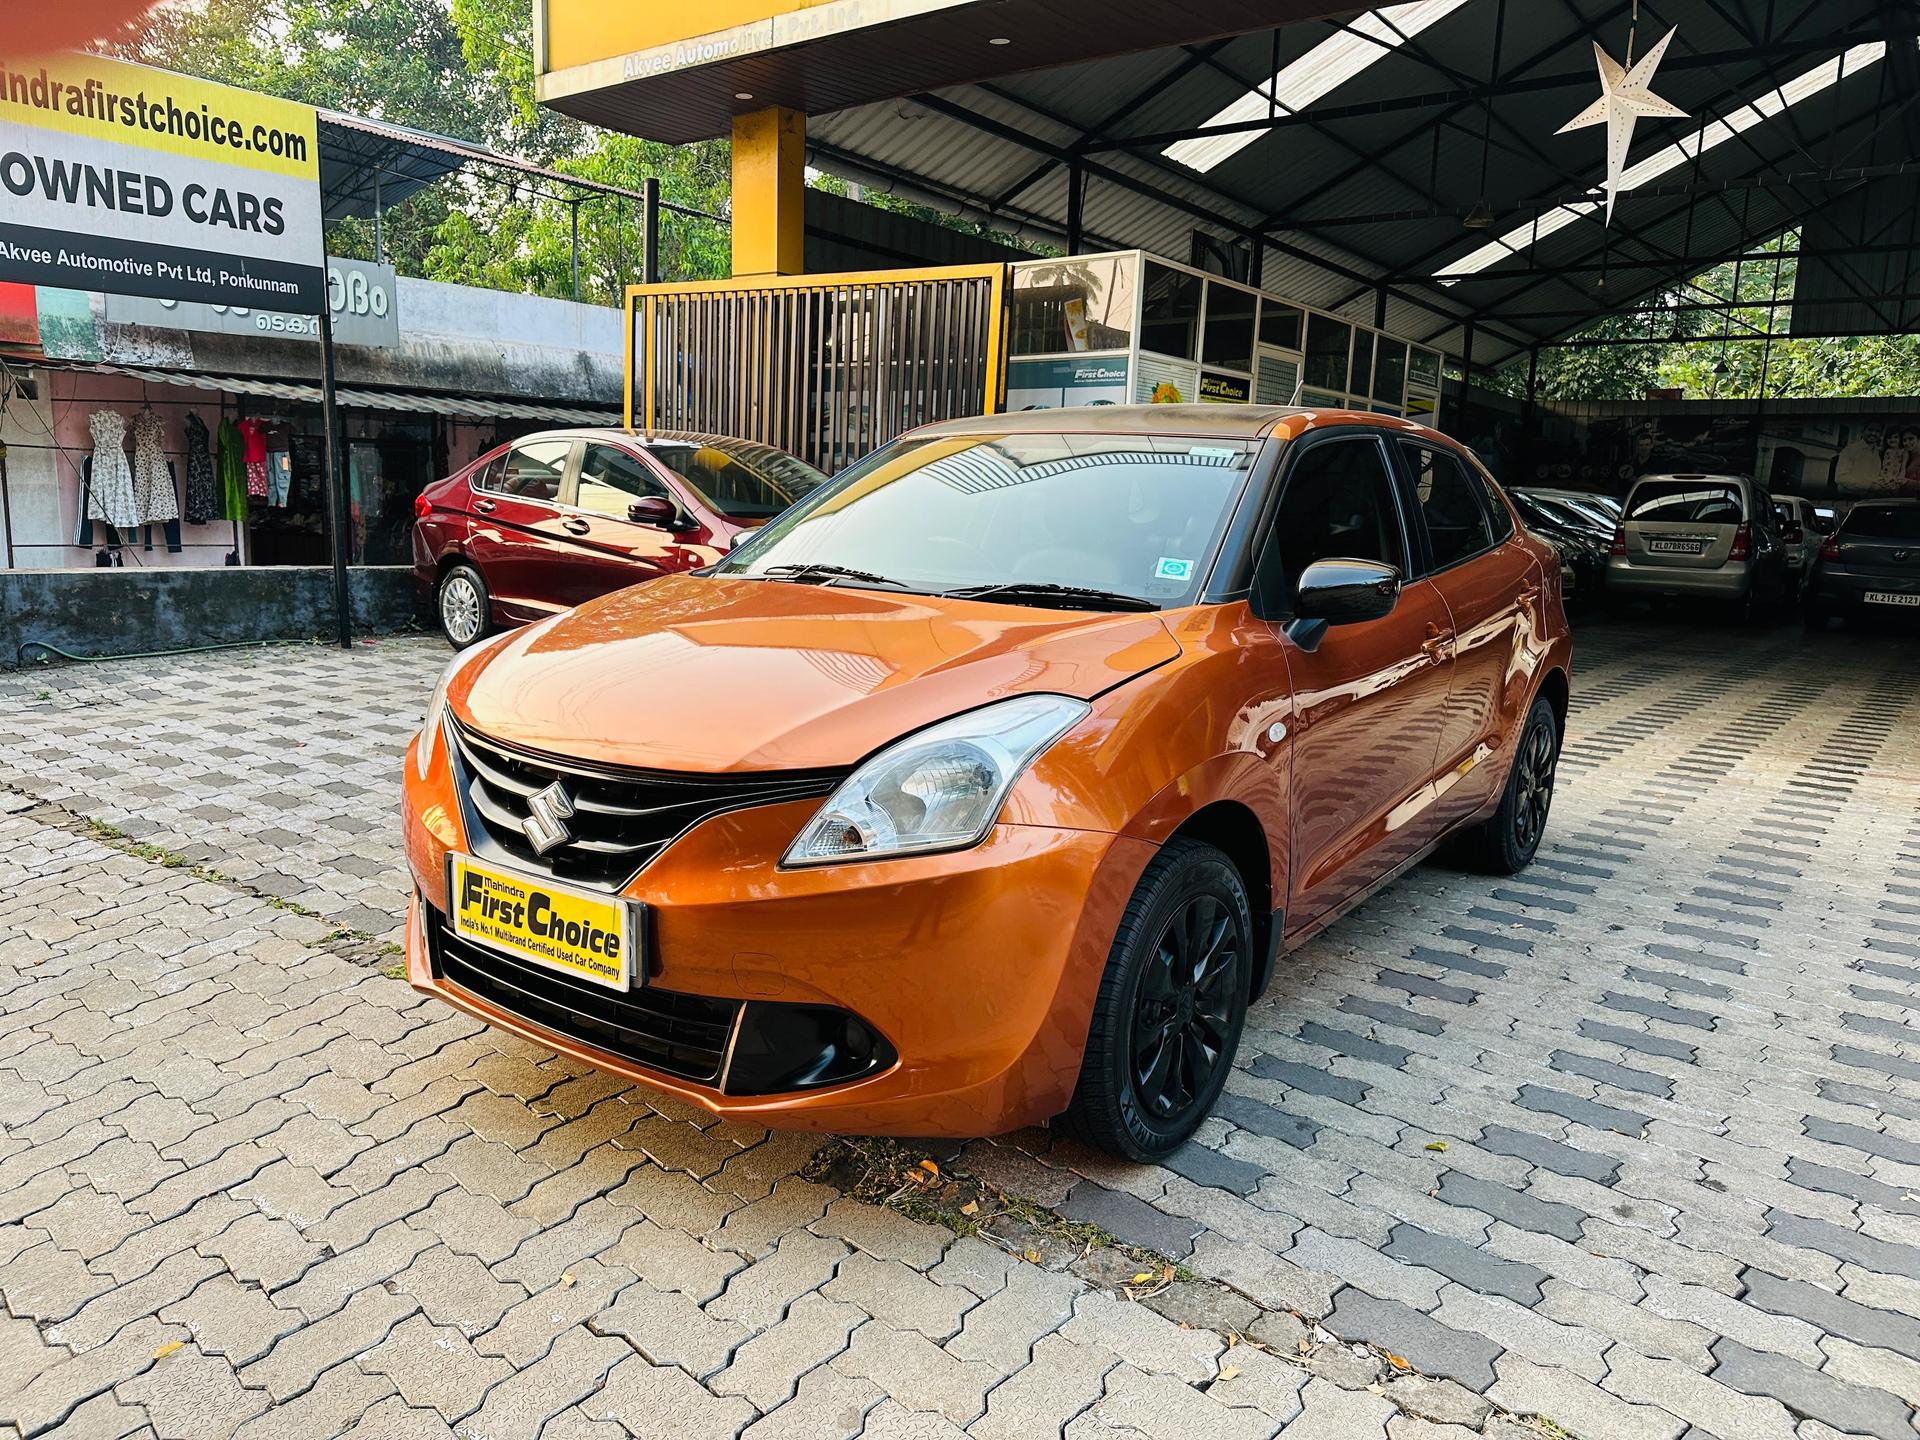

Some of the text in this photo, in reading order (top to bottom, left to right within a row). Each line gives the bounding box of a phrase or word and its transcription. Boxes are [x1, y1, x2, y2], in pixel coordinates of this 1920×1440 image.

[623, 54, 671, 79] Akvee
[0, 151, 285, 236] OWNED CARS
[0, 241, 52, 264] Akvee
[57, 249, 152, 276] Automotive
[157, 261, 184, 280] Pvt
[187, 265, 216, 287] Ltd,
[220, 270, 299, 295] Ponkunnam
[1201, 378, 1243, 397] First Choice
[461, 870, 620, 958] First Choice
[495, 926, 526, 947] Multibrand
[528, 938, 554, 957] Certified
[556, 947, 573, 962] Used
[575, 953, 587, 967] Car
[589, 957, 620, 980] Company
